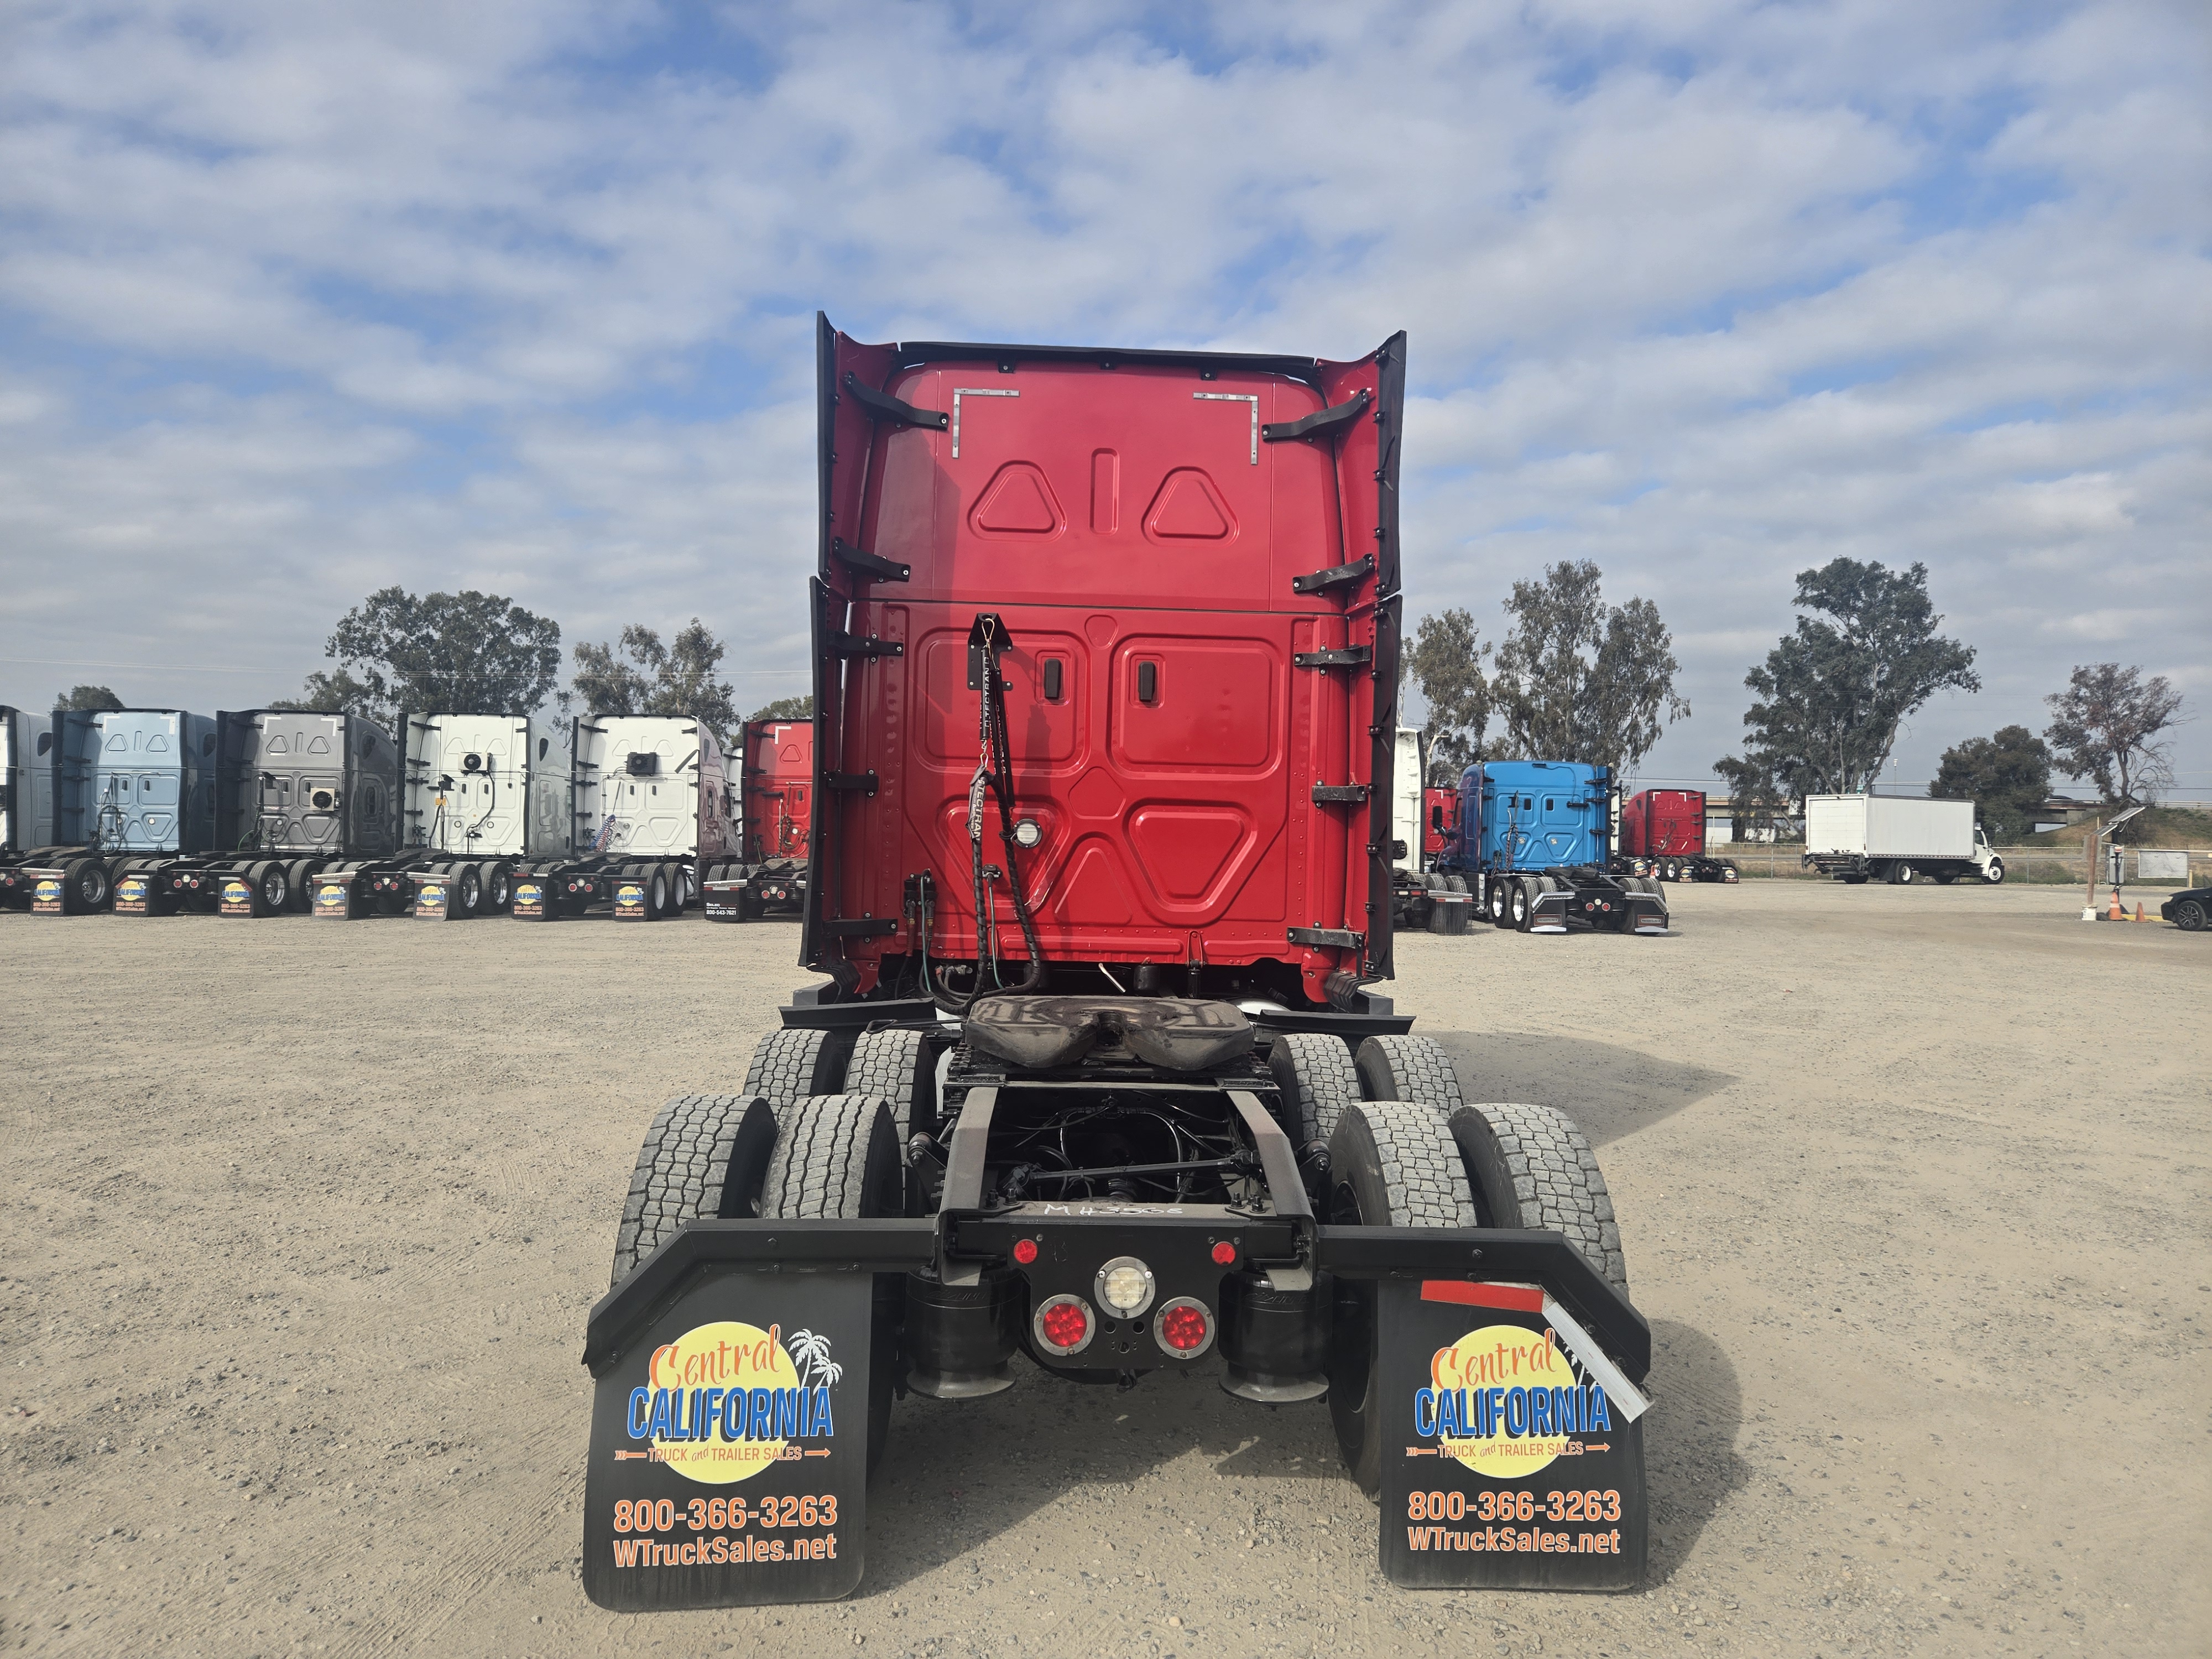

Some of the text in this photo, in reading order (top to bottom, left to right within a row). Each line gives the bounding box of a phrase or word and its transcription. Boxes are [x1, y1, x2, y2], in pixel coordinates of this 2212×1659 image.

[649, 1324, 781, 1391] Central
[1431, 1328, 1556, 1391] Central
[627, 1386, 833, 1441] CALIFORNIA
[1415, 1384, 1611, 1439] CALIFORNIA
[648, 1443, 802, 1462] TRUCK and TRAILER SALES
[1437, 1441, 1584, 1458] TRUCK and TRAILER SALES
[613, 1495, 838, 1532] 800-366-3263
[1407, 1490, 1621, 1522] 800-366-3263
[613, 1533, 837, 1568] WTruckSales.net
[1407, 1526, 1621, 1554] WTruckSales.net
